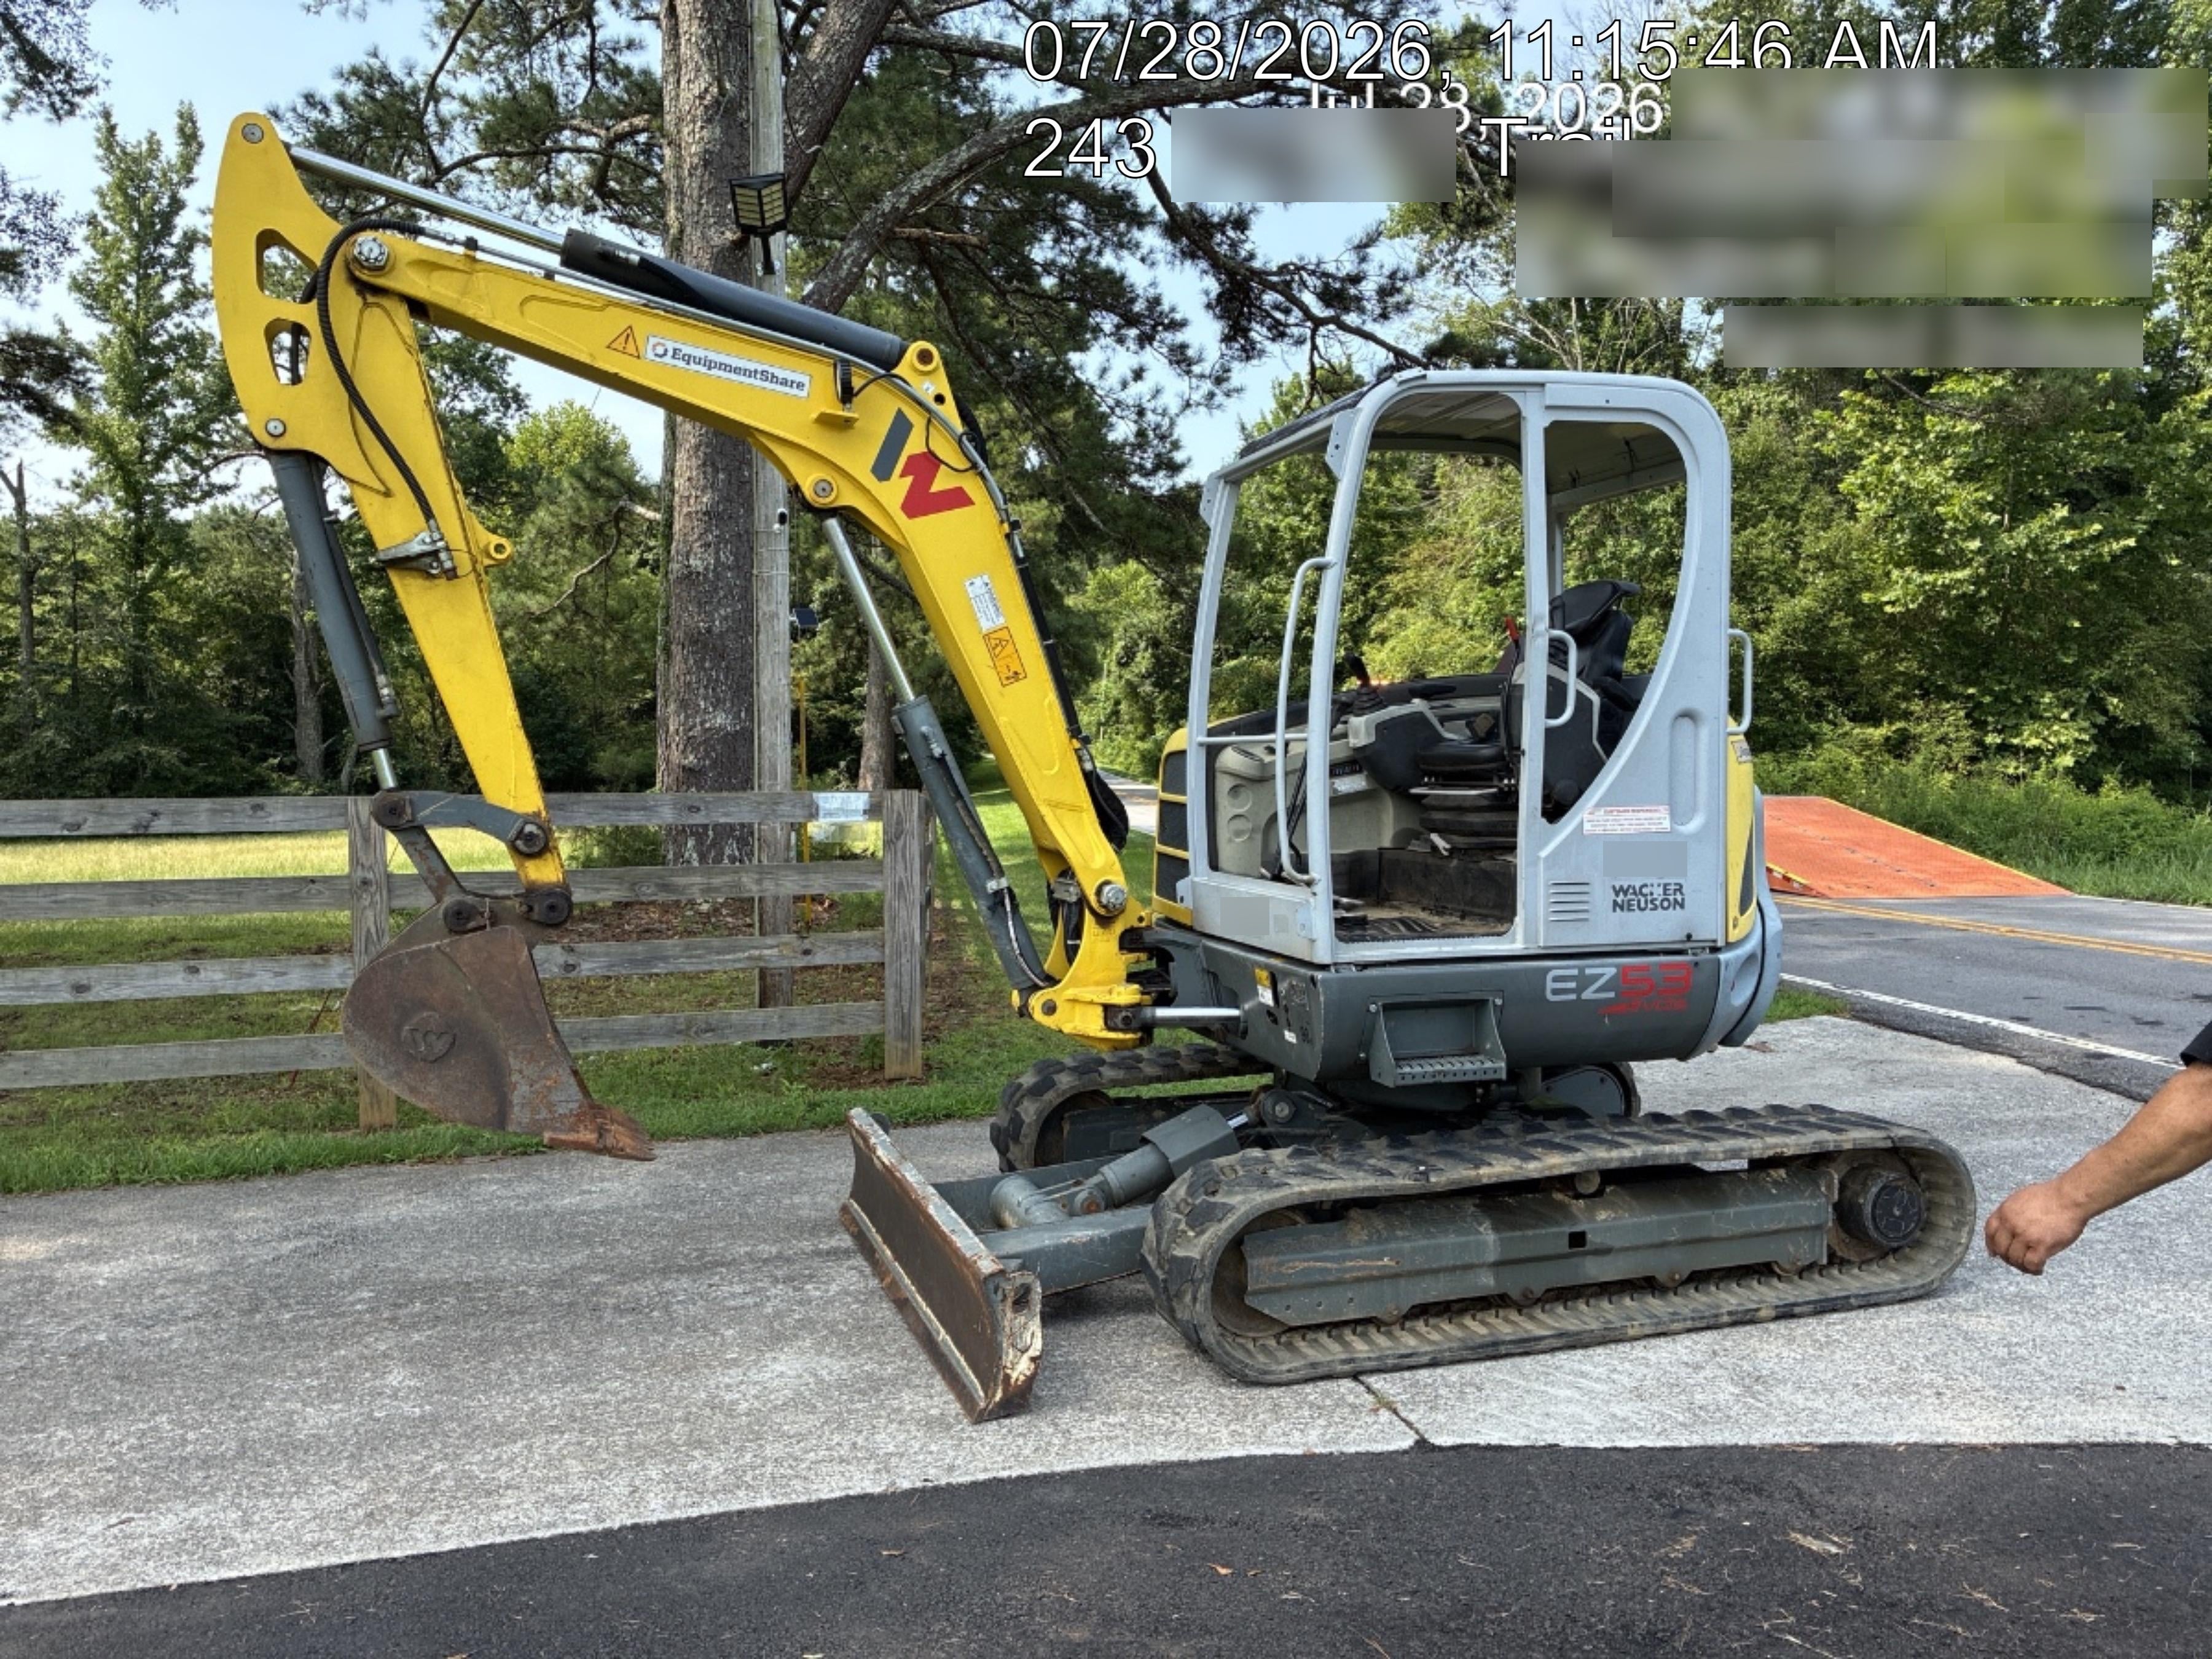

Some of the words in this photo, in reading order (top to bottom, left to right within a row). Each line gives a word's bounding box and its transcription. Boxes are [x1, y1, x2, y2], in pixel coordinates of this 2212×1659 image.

[670, 347, 806, 391] EquipmentShare
[1612, 898, 1685, 912] NEUSON
[1546, 962, 1693, 1002] EZ53
